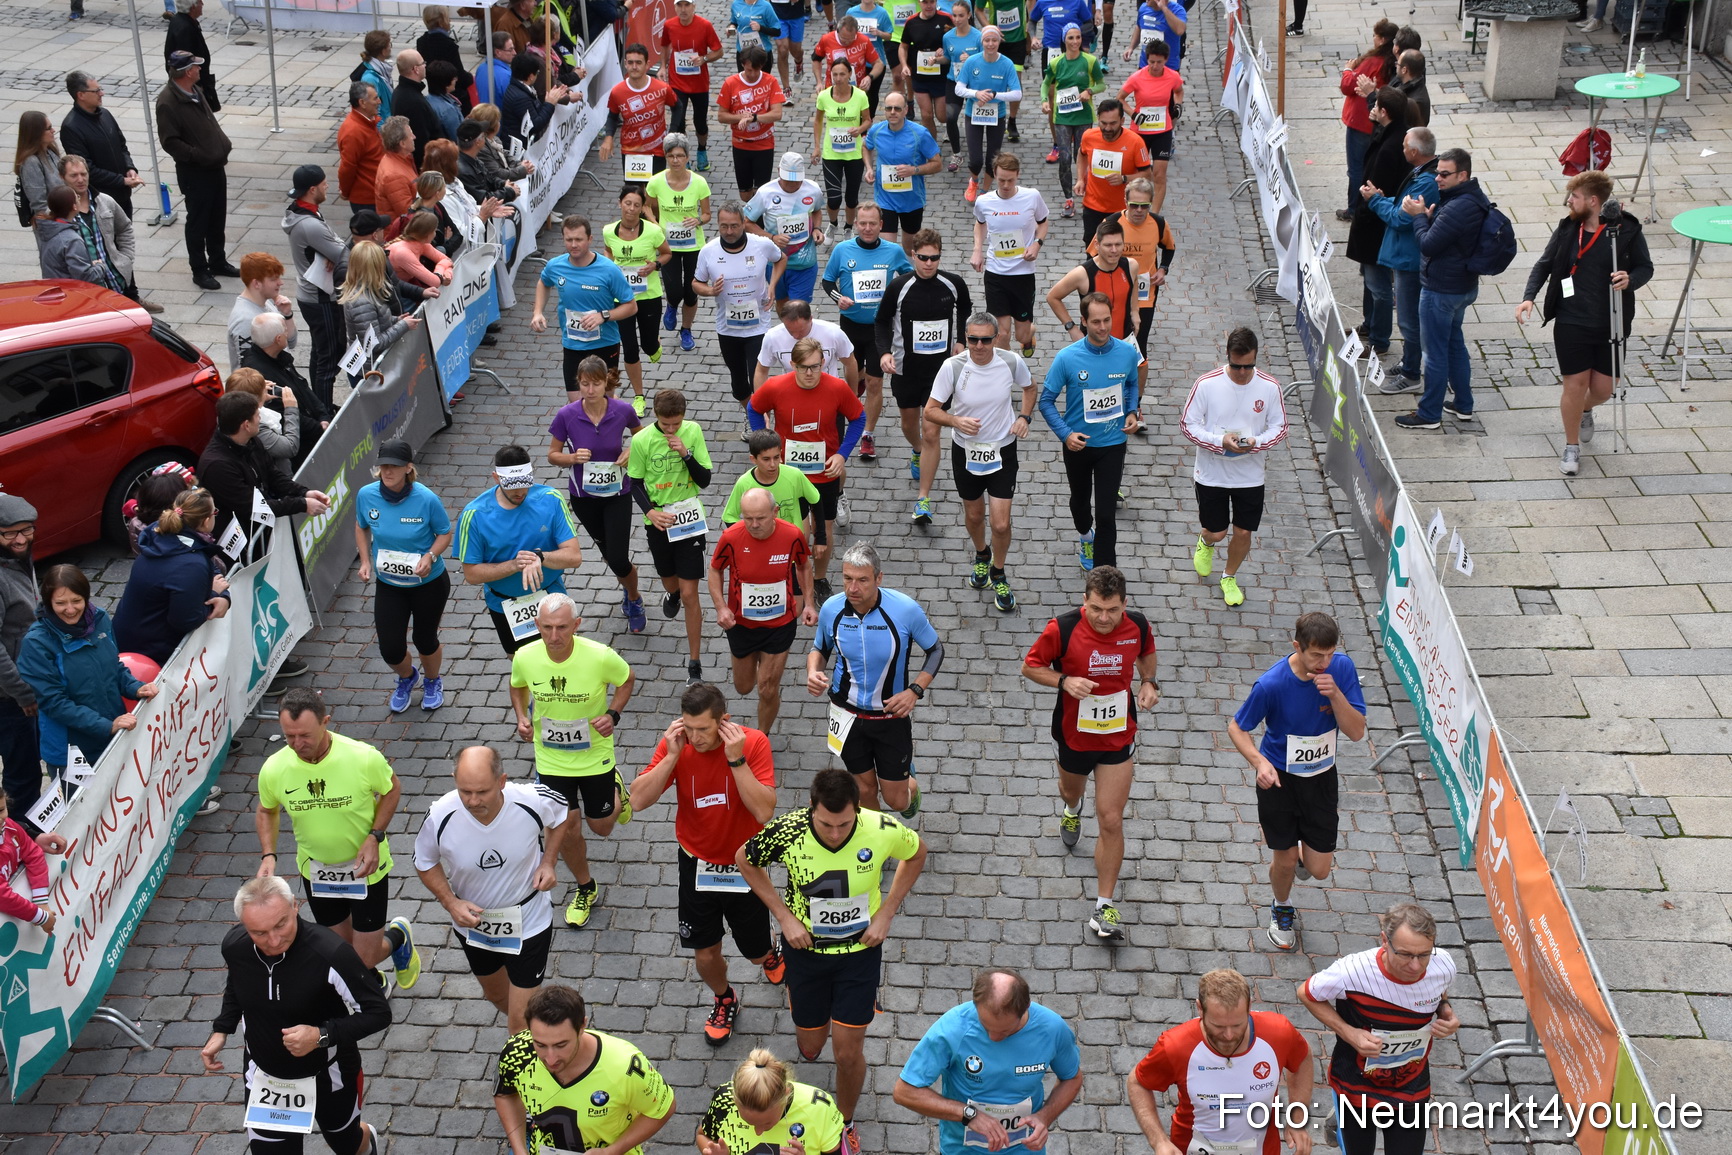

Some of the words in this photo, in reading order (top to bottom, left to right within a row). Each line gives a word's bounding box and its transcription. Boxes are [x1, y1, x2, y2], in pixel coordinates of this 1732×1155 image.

[1000, 15, 1016, 23] 2761
[857, 25, 870, 33] 271
[1060, 94, 1077, 105] 2760
[976, 108, 995, 117] 2753
[833, 135, 853, 143] 2303
[631, 162, 646, 171] 232
[1098, 158, 1114, 169] 401
[669, 230, 692, 239] 2256
[782, 223, 805, 234] 2382
[999, 239, 1017, 250] 112
[1320, 241, 1330, 258] swn
[626, 274, 643, 284] 196
[858, 279, 882, 291] 2922
[730, 310, 754, 320] 2175
[918, 331, 943, 342] 2281
[346, 353, 362, 370] swn
[1090, 394, 1117, 410] 2425
[349, 429, 374, 471] OFFIC
[790, 451, 820, 462] 2464
[970, 450, 996, 463] 2768
[589, 471, 617, 485] 2336
[673, 508, 700, 527] 2025
[225, 533, 239, 552] swn
[769, 553, 790, 562] JURA
[382, 561, 414, 575] 2396
[748, 593, 780, 608] 2332
[1091, 705, 1117, 720] 115
[547, 729, 580, 743] 2314
[88, 762, 132, 866] UNS
[134, 646, 218, 788] LÄUFTS
[1295, 744, 1329, 762] 2044
[37, 796, 61, 823] swn
[317, 869, 356, 882] 2371
[713, 876, 735, 884] Thomas
[104, 888, 151, 968] Service-Line:
[150, 875, 155, 888] 0
[819, 907, 861, 925] 2682
[828, 925, 854, 934] Dominik
[1527, 918, 1539, 934] für
[1533, 933, 1545, 947] die
[485, 937, 501, 945] Josef
[1536, 913, 1562, 962] Neumarkts
[1015, 1063, 1045, 1075] BOCK
[1249, 1080, 1274, 1092] KOPPE
[259, 1087, 306, 1108] 2710
[269, 1111, 292, 1121] Walter
